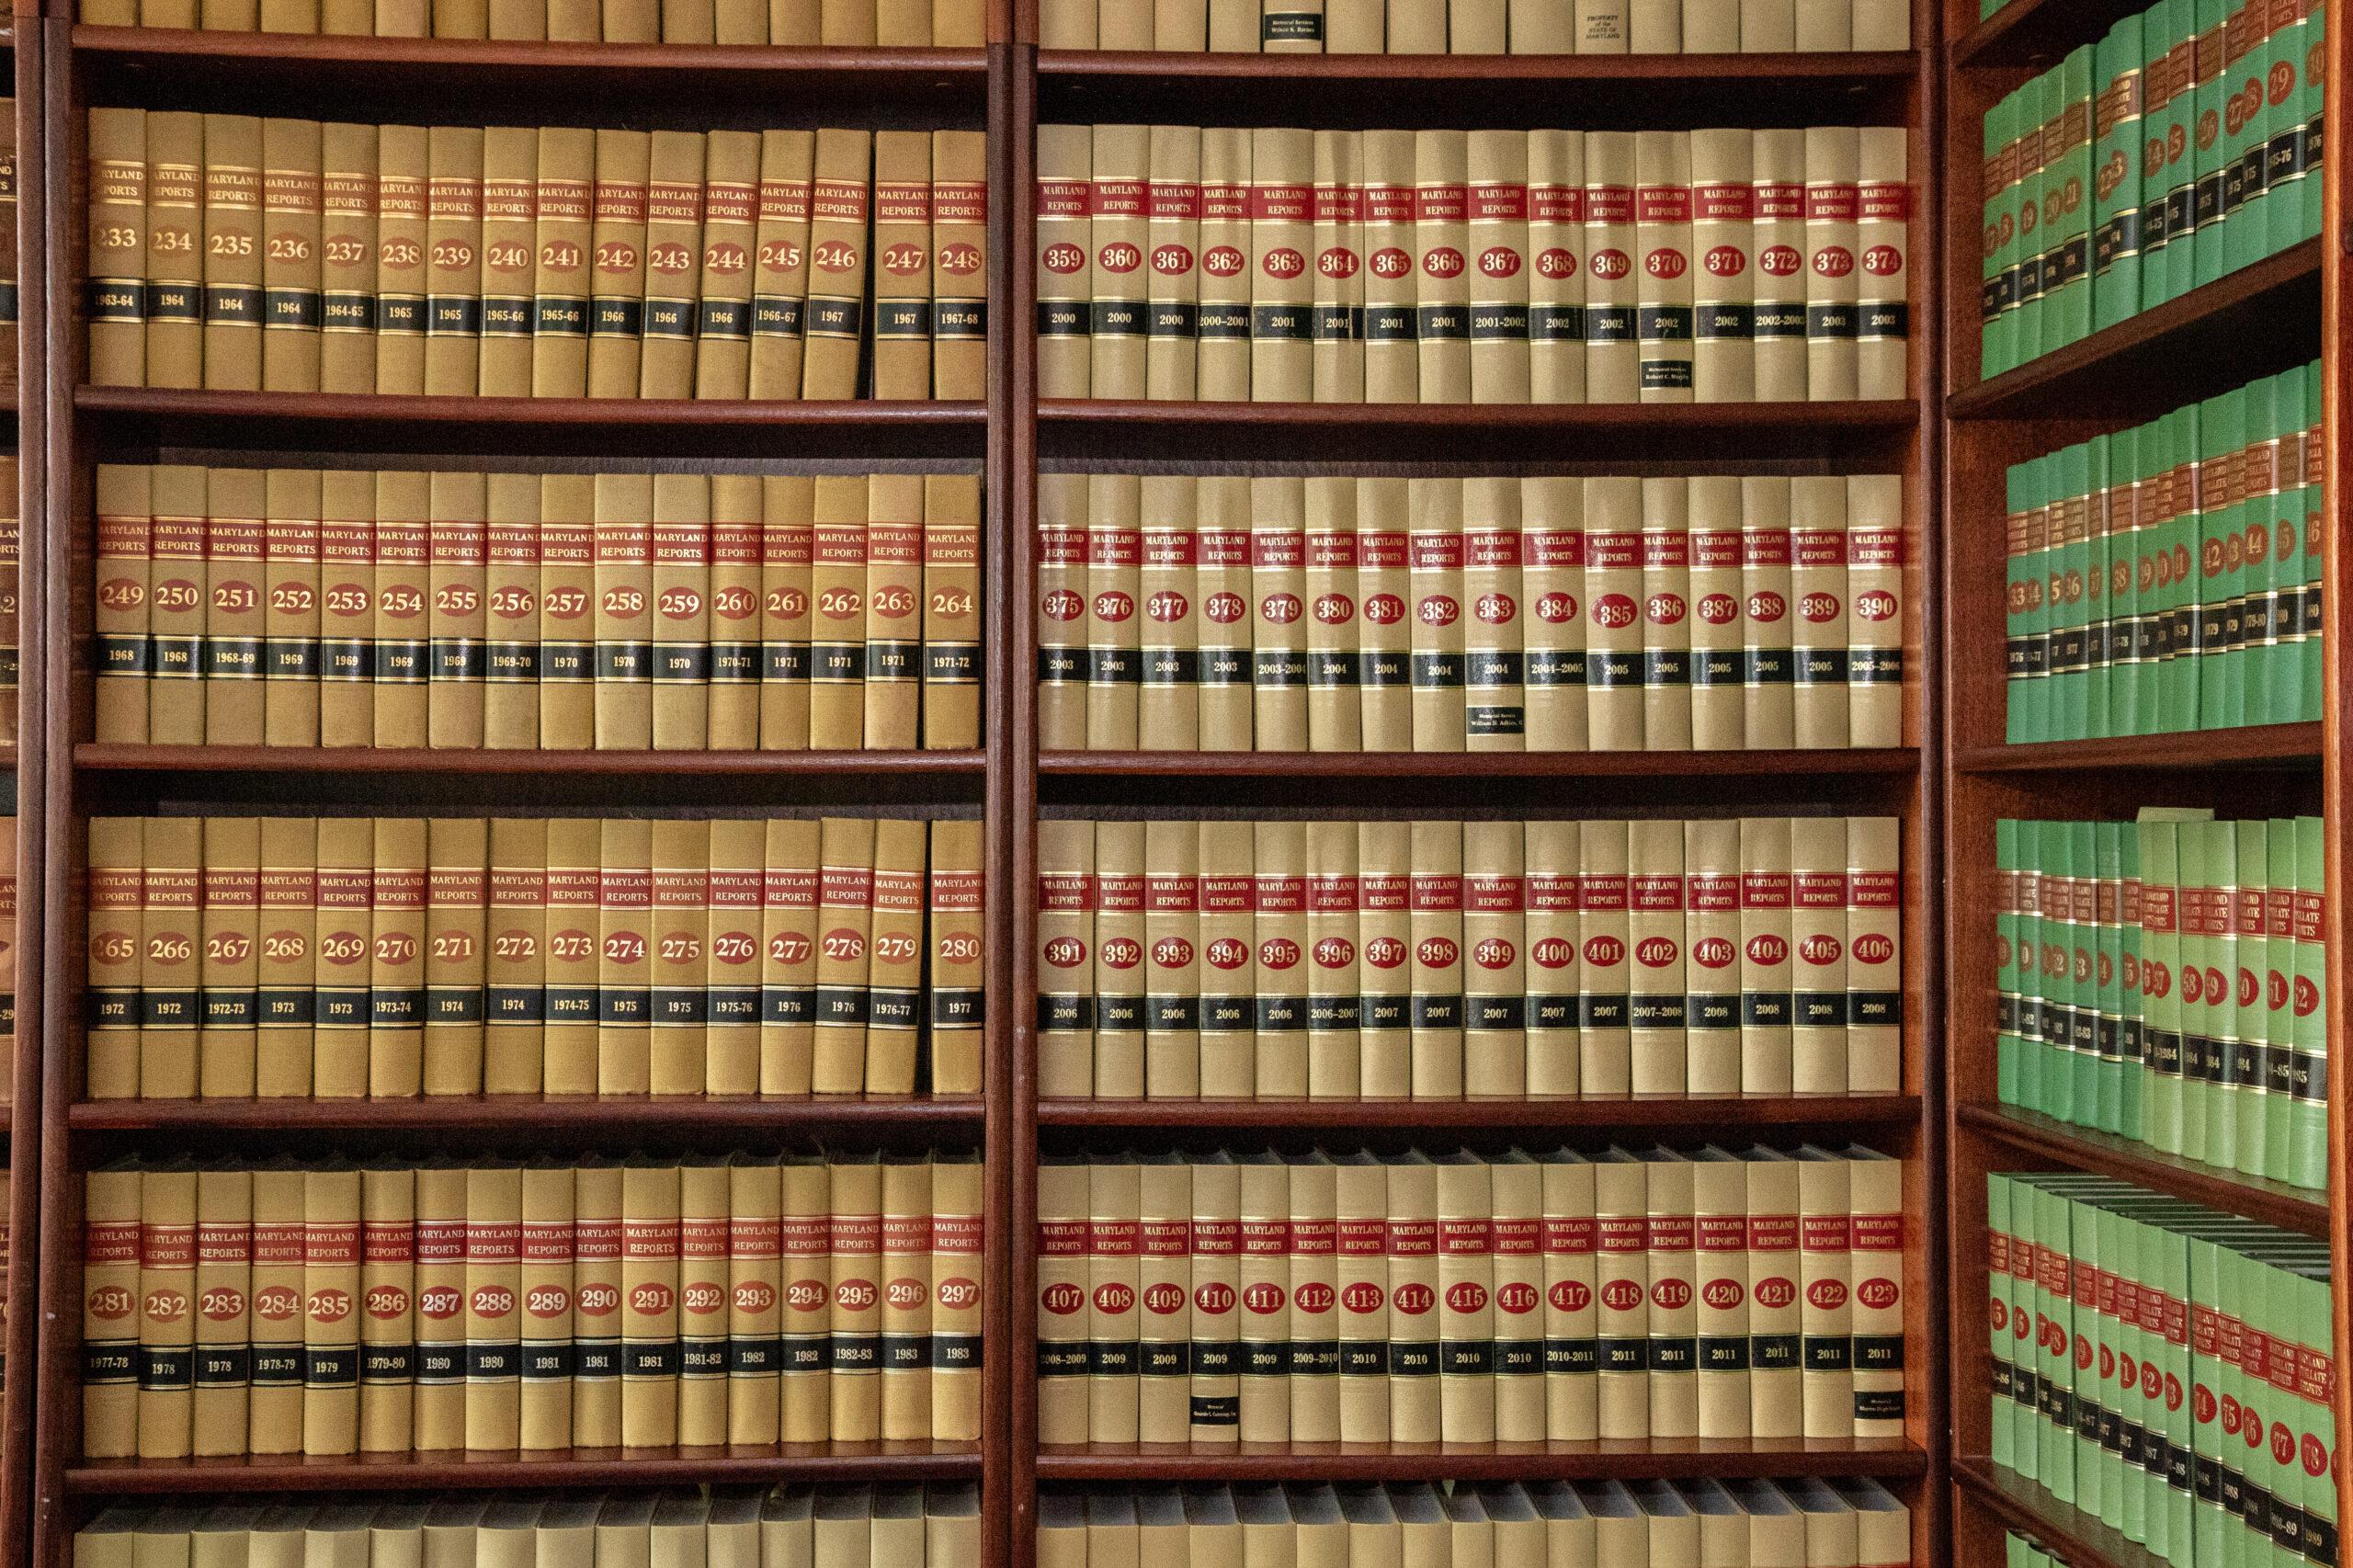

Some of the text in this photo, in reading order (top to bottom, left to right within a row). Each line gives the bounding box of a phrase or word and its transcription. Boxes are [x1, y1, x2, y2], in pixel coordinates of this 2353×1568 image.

[538, 187, 590, 199] MARYLAND
[1043, 186, 1086, 196] MARYLAND
[1478, 189, 1519, 199] MARYLAND
[431, 202, 475, 213] REPORTS
[487, 202, 531, 213] REPORTS
[762, 203, 805, 214] REPORTS
[1048, 200, 1082, 210] REPORTS
[1482, 204, 1517, 215] REPORTS
[211, 235, 253, 255] 235
[270, 242, 309, 259] 236
[326, 243, 364, 262] 237
[433, 246, 472, 265] 239
[490, 247, 528, 266] 240
[542, 249, 579, 266] 241
[651, 250, 689, 267] 243
[761, 247, 801, 266] 245
[885, 251, 925, 268] 247
[940, 251, 980, 267] 248
[1048, 249, 1081, 267] 359
[1104, 248, 1137, 267] 360
[1156, 254, 1188, 268] 361
[1209, 253, 1240, 269] 362
[1484, 254, 1517, 270] 367
[1650, 255, 1682, 272] 370
[1710, 254, 1741, 270] 371
[1765, 253, 1797, 269] 372
[219, 299, 243, 310] 1964
[439, 309, 461, 320] 1965
[655, 312, 677, 324] 1966
[941, 312, 978, 324] 1967-68
[1051, 313, 1075, 324] 2000
[1271, 316, 1295, 327] 2001
[1715, 316, 1738, 326] 2002
[432, 531, 485, 542] MARYLAND
[927, 533, 977, 543] MARYLAND
[1204, 535, 1245, 546] MARYLAND
[1472, 535, 1515, 546] MARYLAND
[436, 547, 481, 558] REPORTS
[933, 549, 974, 559] REPORTS
[1208, 550, 1242, 561] REPORTS
[1477, 550, 1511, 561] REPORTS
[157, 587, 199, 606] 250
[215, 589, 256, 608] 251
[273, 591, 313, 609] 252
[382, 593, 422, 612] 254
[437, 592, 477, 610] 255
[546, 594, 585, 612] 257
[661, 596, 699, 613] 259
[768, 595, 805, 612] 261
[822, 596, 860, 613] 262
[933, 596, 972, 613] 264
[1047, 597, 1079, 614] 375
[1150, 598, 1183, 616] 377
[1210, 598, 1241, 615] 378
[1266, 600, 1299, 617] 379
[1424, 602, 1455, 619] 382
[1479, 600, 1511, 617] 383
[1540, 599, 1573, 617] 384
[1651, 599, 1681, 617] 386
[1751, 598, 1781, 615] 388
[1860, 598, 1893, 615] 390
[215, 653, 255, 664] 1968-69
[493, 656, 530, 667] 1969-70
[554, 656, 578, 667] 1970
[934, 657, 969, 668] 1971-72
[1214, 661, 1238, 672] 2003
[1756, 661, 1779, 672] 2005
[1324, 664, 1347, 675] 2004
[1484, 664, 1508, 675] 2004
[492, 876, 542, 887] MARYLAND
[711, 876, 761, 887] MARYLAND
[1206, 881, 1248, 892] MARYLAND
[1473, 881, 1516, 892] MARYLAND
[496, 892, 539, 902] REPORTS
[716, 892, 756, 902] REPORTS
[1210, 896, 1245, 906] REPORTS
[1478, 896, 1513, 906] REPORTS
[151, 940, 191, 959] 266
[209, 939, 250, 958] 267
[323, 939, 364, 958] 269
[377, 941, 416, 959] 270
[496, 937, 536, 955] 272
[554, 937, 593, 955] 273
[606, 939, 644, 959] 274
[716, 938, 755, 957] 276
[824, 937, 863, 957] 278
[940, 939, 980, 958] 280
[1049, 944, 1082, 962] 391
[1105, 945, 1138, 962] 392
[1211, 945, 1244, 962] 394
[1319, 944, 1351, 962] 396
[1422, 944, 1454, 961] 398
[1479, 945, 1512, 962] 399
[1537, 944, 1570, 961] 400
[1641, 944, 1674, 960] 402
[1751, 942, 1784, 959] 404
[1858, 940, 1891, 958] 406
[157, 1003, 180, 1014] 1972
[271, 1001, 294, 1013] 1973
[554, 1000, 589, 1011] 1974-75
[949, 1002, 972, 1013] 1977
[1375, 1007, 1399, 1018] 2007
[1483, 1007, 1507, 1018] 2007
[1756, 1004, 1779, 1015] 2008
[1216, 1009, 1240, 1019] 2006
[467, 1229, 519, 1240] MARYLAND
[934, 1222, 983, 1233] MARYLAND
[1392, 1226, 1434, 1236] MARYLAND
[1600, 1222, 1643, 1233] MARYLAND
[471, 1244, 515, 1255] REPORTS
[938, 1237, 978, 1247] REPORTS
[1396, 1241, 1431, 1251] REPORTS
[1605, 1237, 1640, 1247] REPORTS
[635, 1290, 671, 1308] 291
[736, 1288, 771, 1306] 293
[839, 1286, 875, 1303] 295
[941, 1284, 977, 1301] 297
[1048, 1290, 1080, 1307] 407
[1148, 1290, 1182, 1307] 409
[1199, 1290, 1233, 1306] 410
[1299, 1290, 1332, 1306] 412
[1398, 1292, 1431, 1309] 414
[1502, 1290, 1535, 1307] 416
[1607, 1288, 1639, 1304] 418
[1707, 1287, 1740, 1304] 420
[1760, 1285, 1792, 1301] 421
[1862, 1285, 1894, 1302] 423
[147, 1297, 186, 1316] 282
[201, 1295, 243, 1312] 283
[308, 1296, 349, 1314] 285
[422, 1294, 458, 1312] 287
[475, 1294, 512, 1312] 288
[530, 1292, 566, 1311] 289
[835, 1348, 872, 1359] 1982-83
[1153, 1354, 1176, 1365] 2009
[1404, 1354, 1427, 1365] 2010
[1868, 1348, 1891, 1359] 2011
[209, 1361, 232, 1372] 1978
[480, 1356, 504, 1368] 1980
[639, 1356, 663, 1368] 1981
[2223, 1403, 2235, 1426] 75
[2274, 1432, 2288, 1457] 77
[2305, 1529, 2322, 1547] 1989
